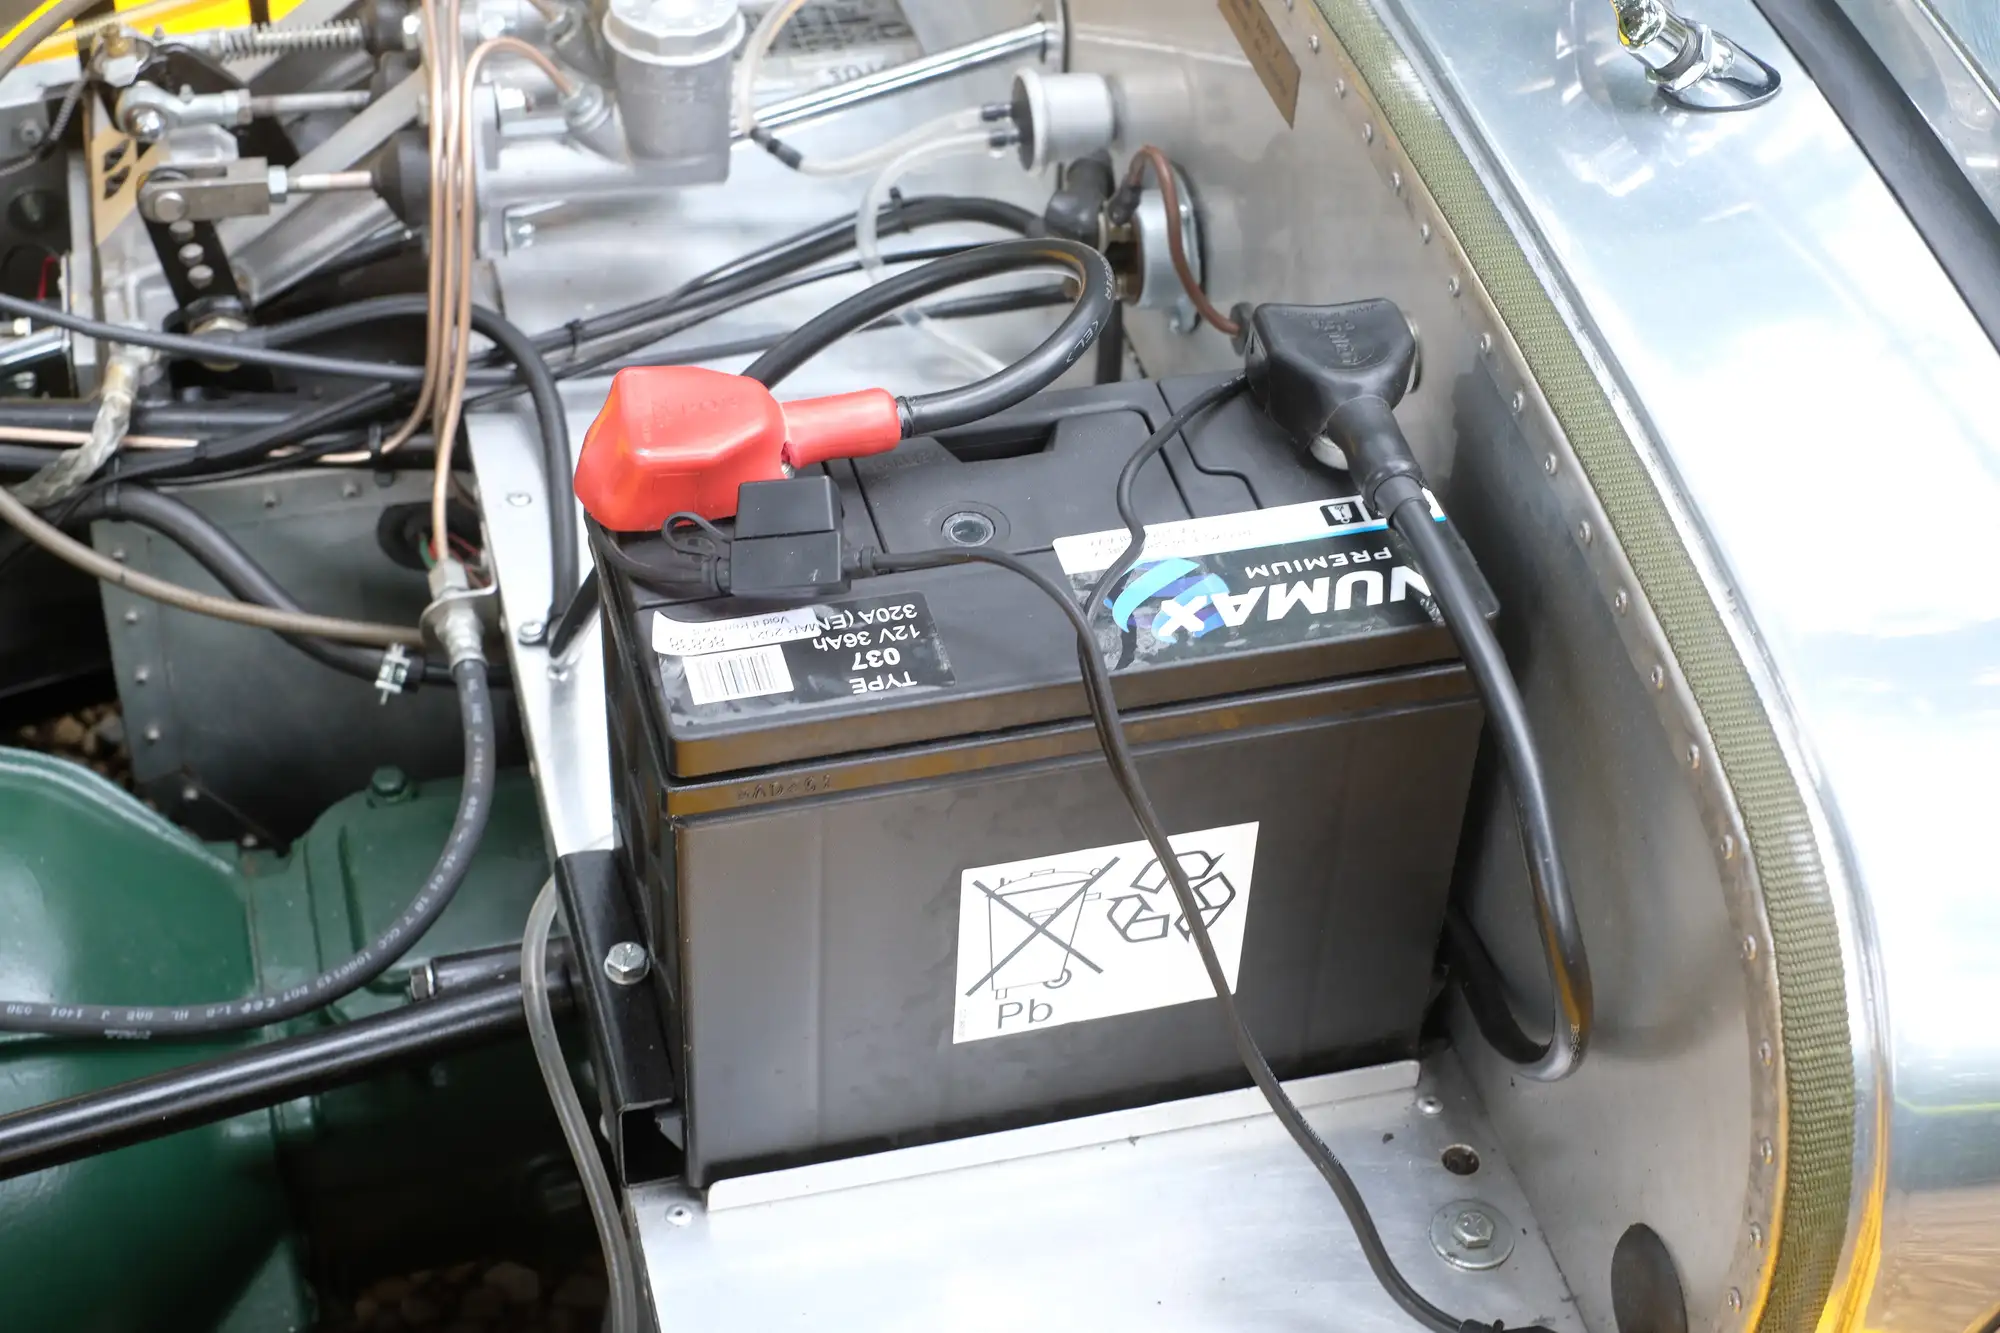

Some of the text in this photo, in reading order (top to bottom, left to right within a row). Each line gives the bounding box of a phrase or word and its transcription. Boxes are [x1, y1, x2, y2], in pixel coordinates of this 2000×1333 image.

[1244, 546, 1392, 580] PREMIUM
[857, 603, 918, 624] 320A
[1155, 563, 1431, 638] NUMAX
[812, 622, 921, 653] 12V 36Ah
[850, 646, 901, 671] 037
[848, 668, 918, 695] TYPE
[997, 999, 1053, 1030] Pb
